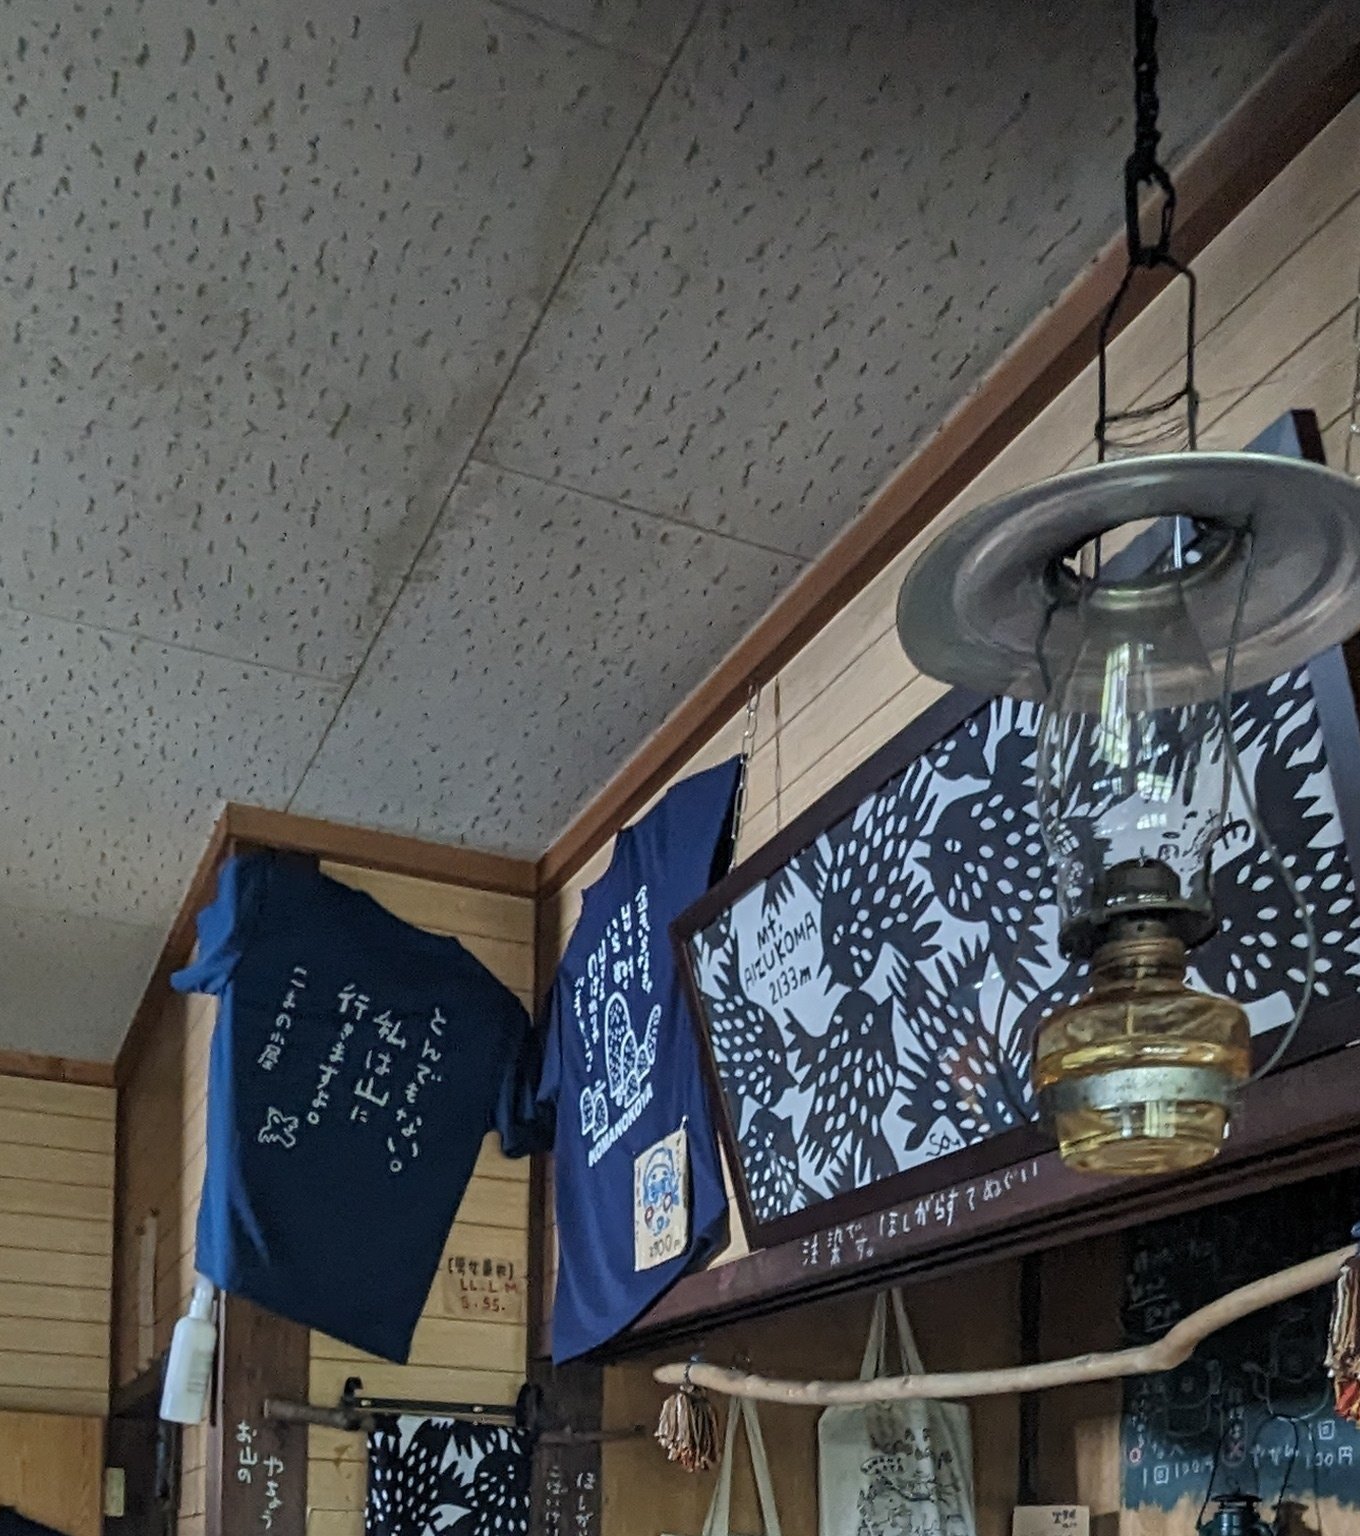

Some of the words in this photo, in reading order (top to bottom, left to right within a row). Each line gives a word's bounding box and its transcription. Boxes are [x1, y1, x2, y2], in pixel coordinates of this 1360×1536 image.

[744, 911, 818, 992] AIZUKOMA
[757, 911, 783, 949] Mt.
[768, 965, 812, 1006] 2133m
[307, 983, 370, 1125] 行きますよ。
[350, 1010, 407, 1123] 私は山に
[386, 1008, 446, 1173] とんでもない。
[235, 1419, 258, 1484] お山の
